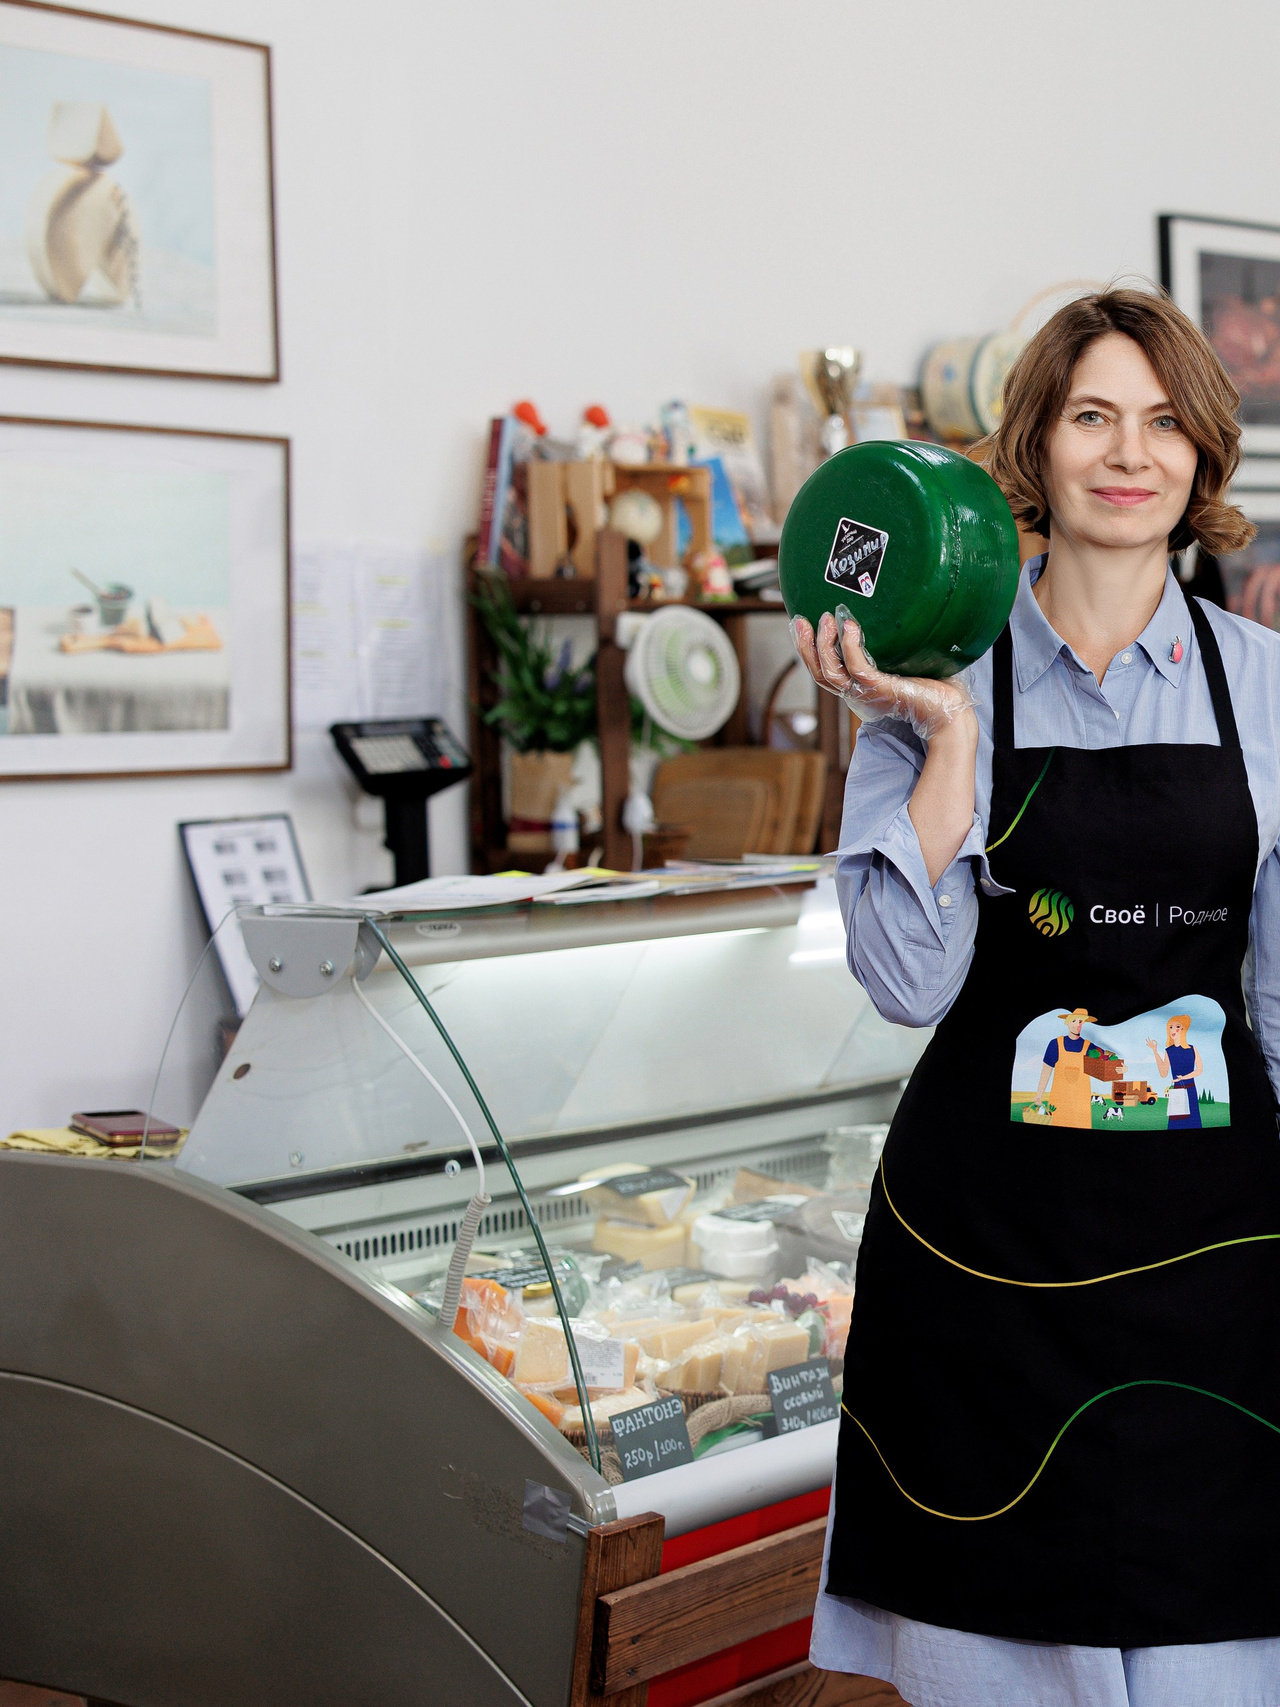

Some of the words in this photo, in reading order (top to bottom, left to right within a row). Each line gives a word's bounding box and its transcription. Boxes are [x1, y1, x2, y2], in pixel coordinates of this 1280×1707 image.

[1090, 905, 1145, 924] Своё
[1170, 906, 1227, 925] Родное
[612, 1399, 683, 1438] ФАНТОНЭ
